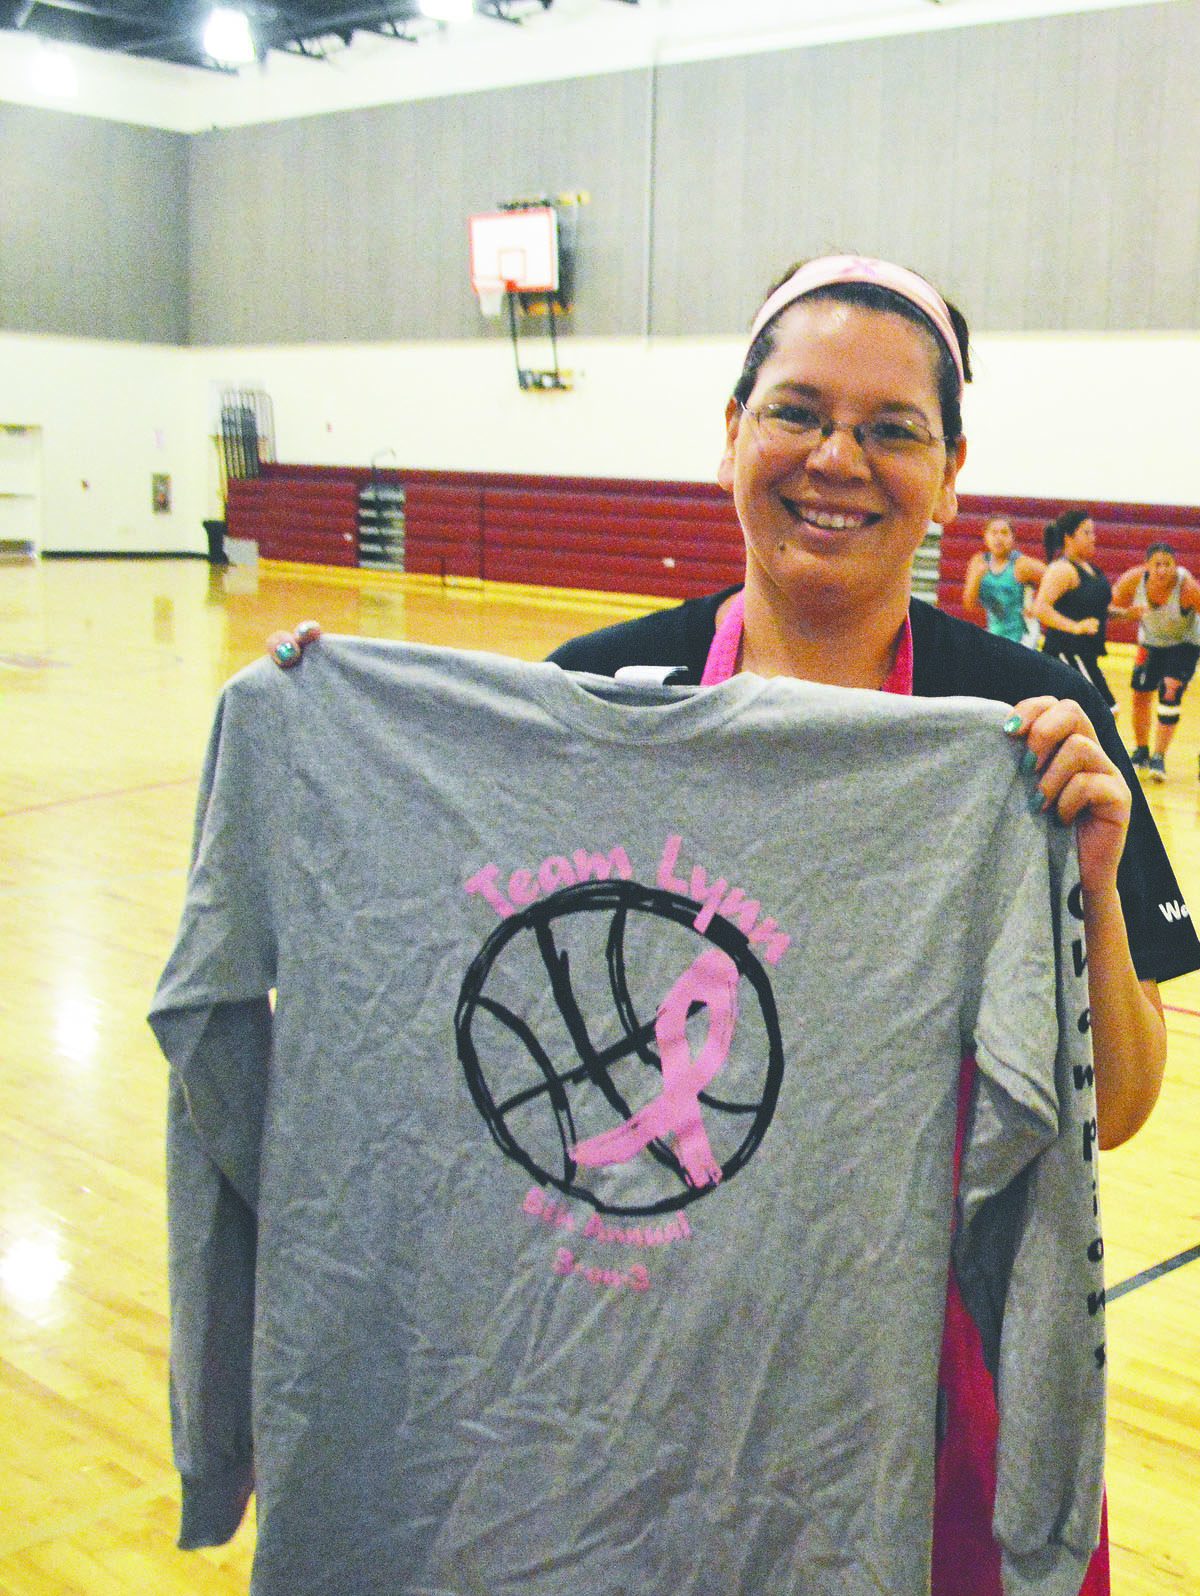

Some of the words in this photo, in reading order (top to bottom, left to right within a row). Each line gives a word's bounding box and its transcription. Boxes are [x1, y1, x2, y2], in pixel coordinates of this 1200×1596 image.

[464, 847, 633, 918] Team
[657, 834, 791, 965] Lynn
[583, 1213, 690, 1246] Annual
